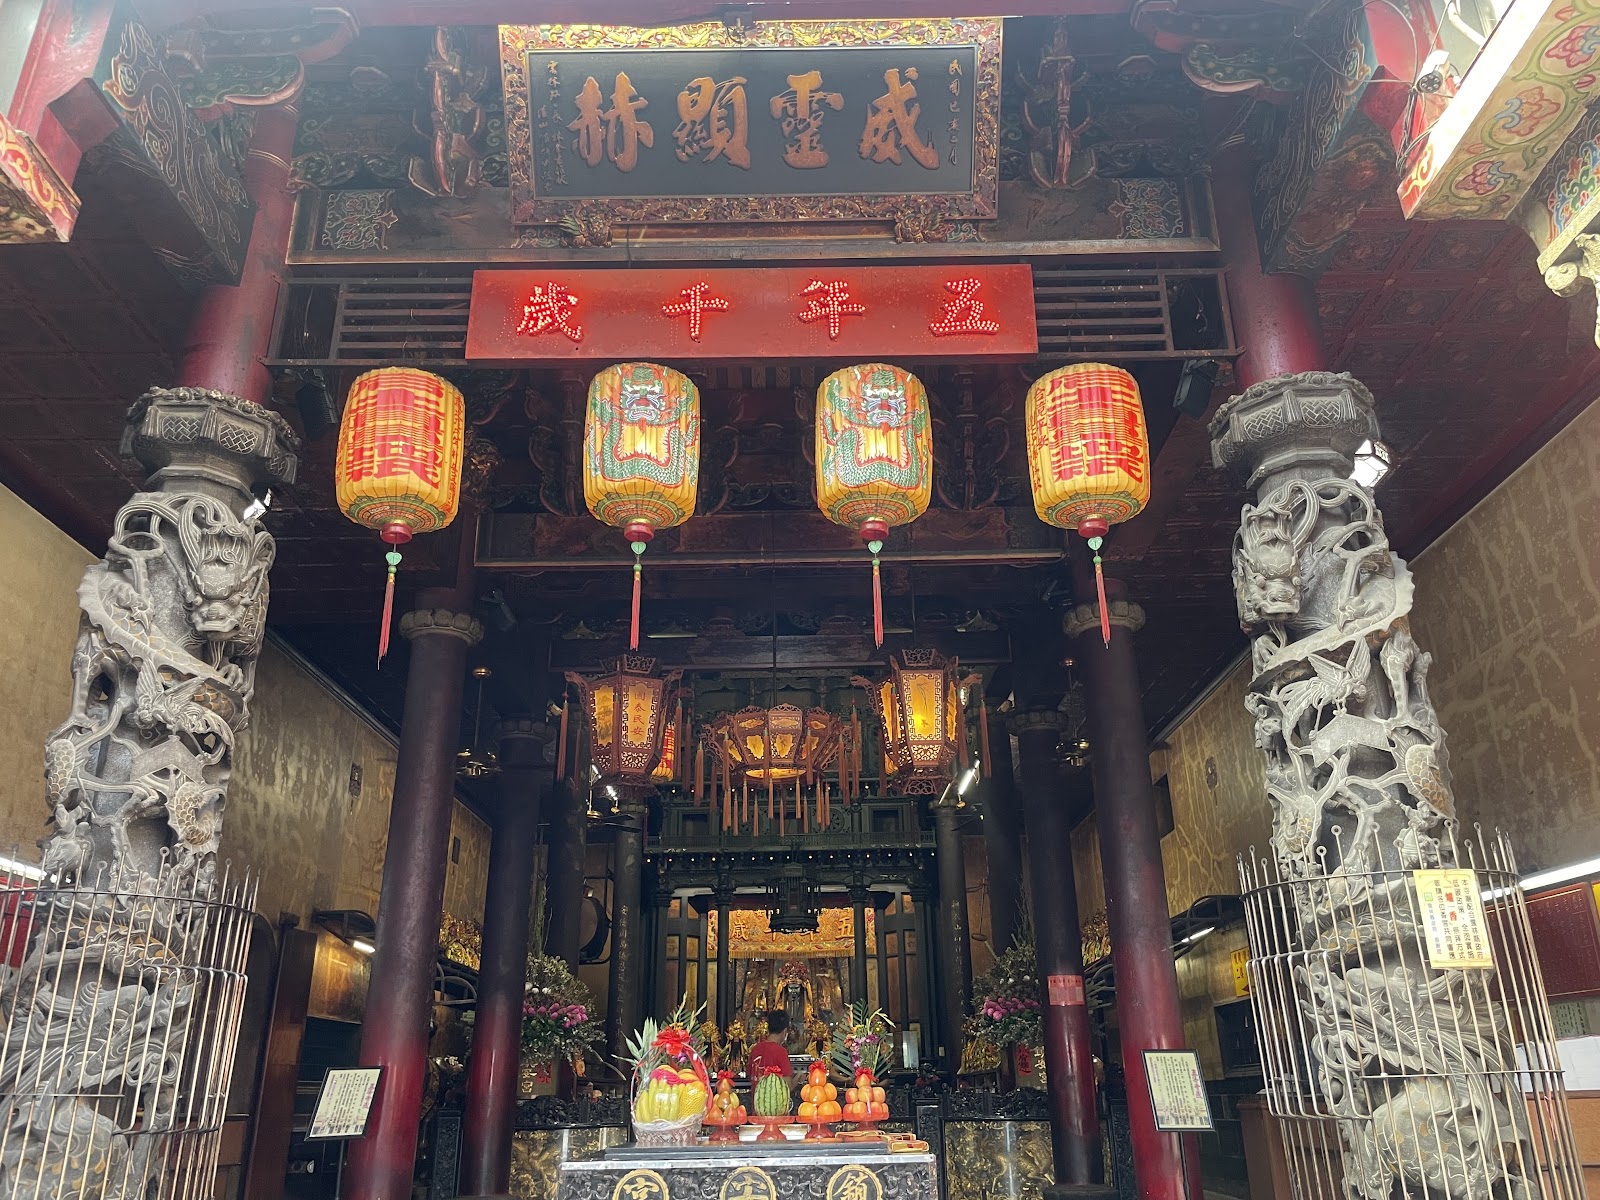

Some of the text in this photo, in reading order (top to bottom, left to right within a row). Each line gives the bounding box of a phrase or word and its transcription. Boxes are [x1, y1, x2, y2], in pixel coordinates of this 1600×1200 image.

[566, 67, 940, 173] 威靈顯赫
[516, 277, 1000, 343] 五年千歲
